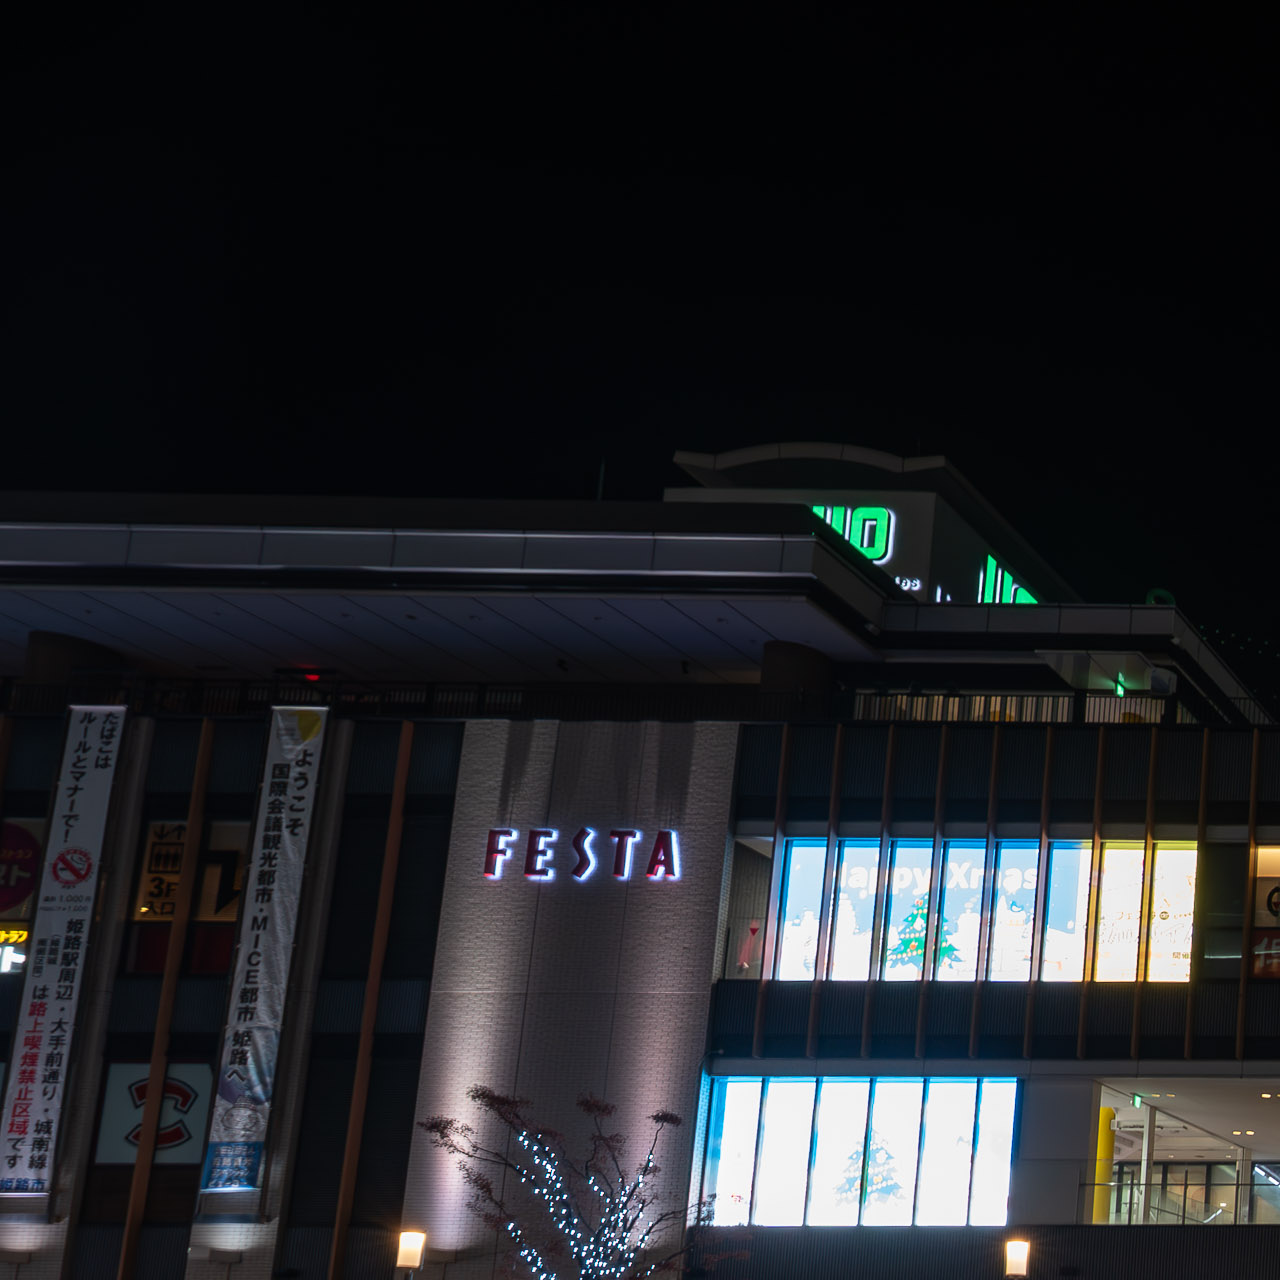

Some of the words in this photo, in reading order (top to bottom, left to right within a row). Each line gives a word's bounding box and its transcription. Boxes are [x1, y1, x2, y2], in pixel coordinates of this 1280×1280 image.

[286, 749, 314, 837] ようこそ
[484, 826, 684, 881] FESTA
[149, 877, 180, 898] 3F
[227, 1030, 253, 1082] 姫路へ
